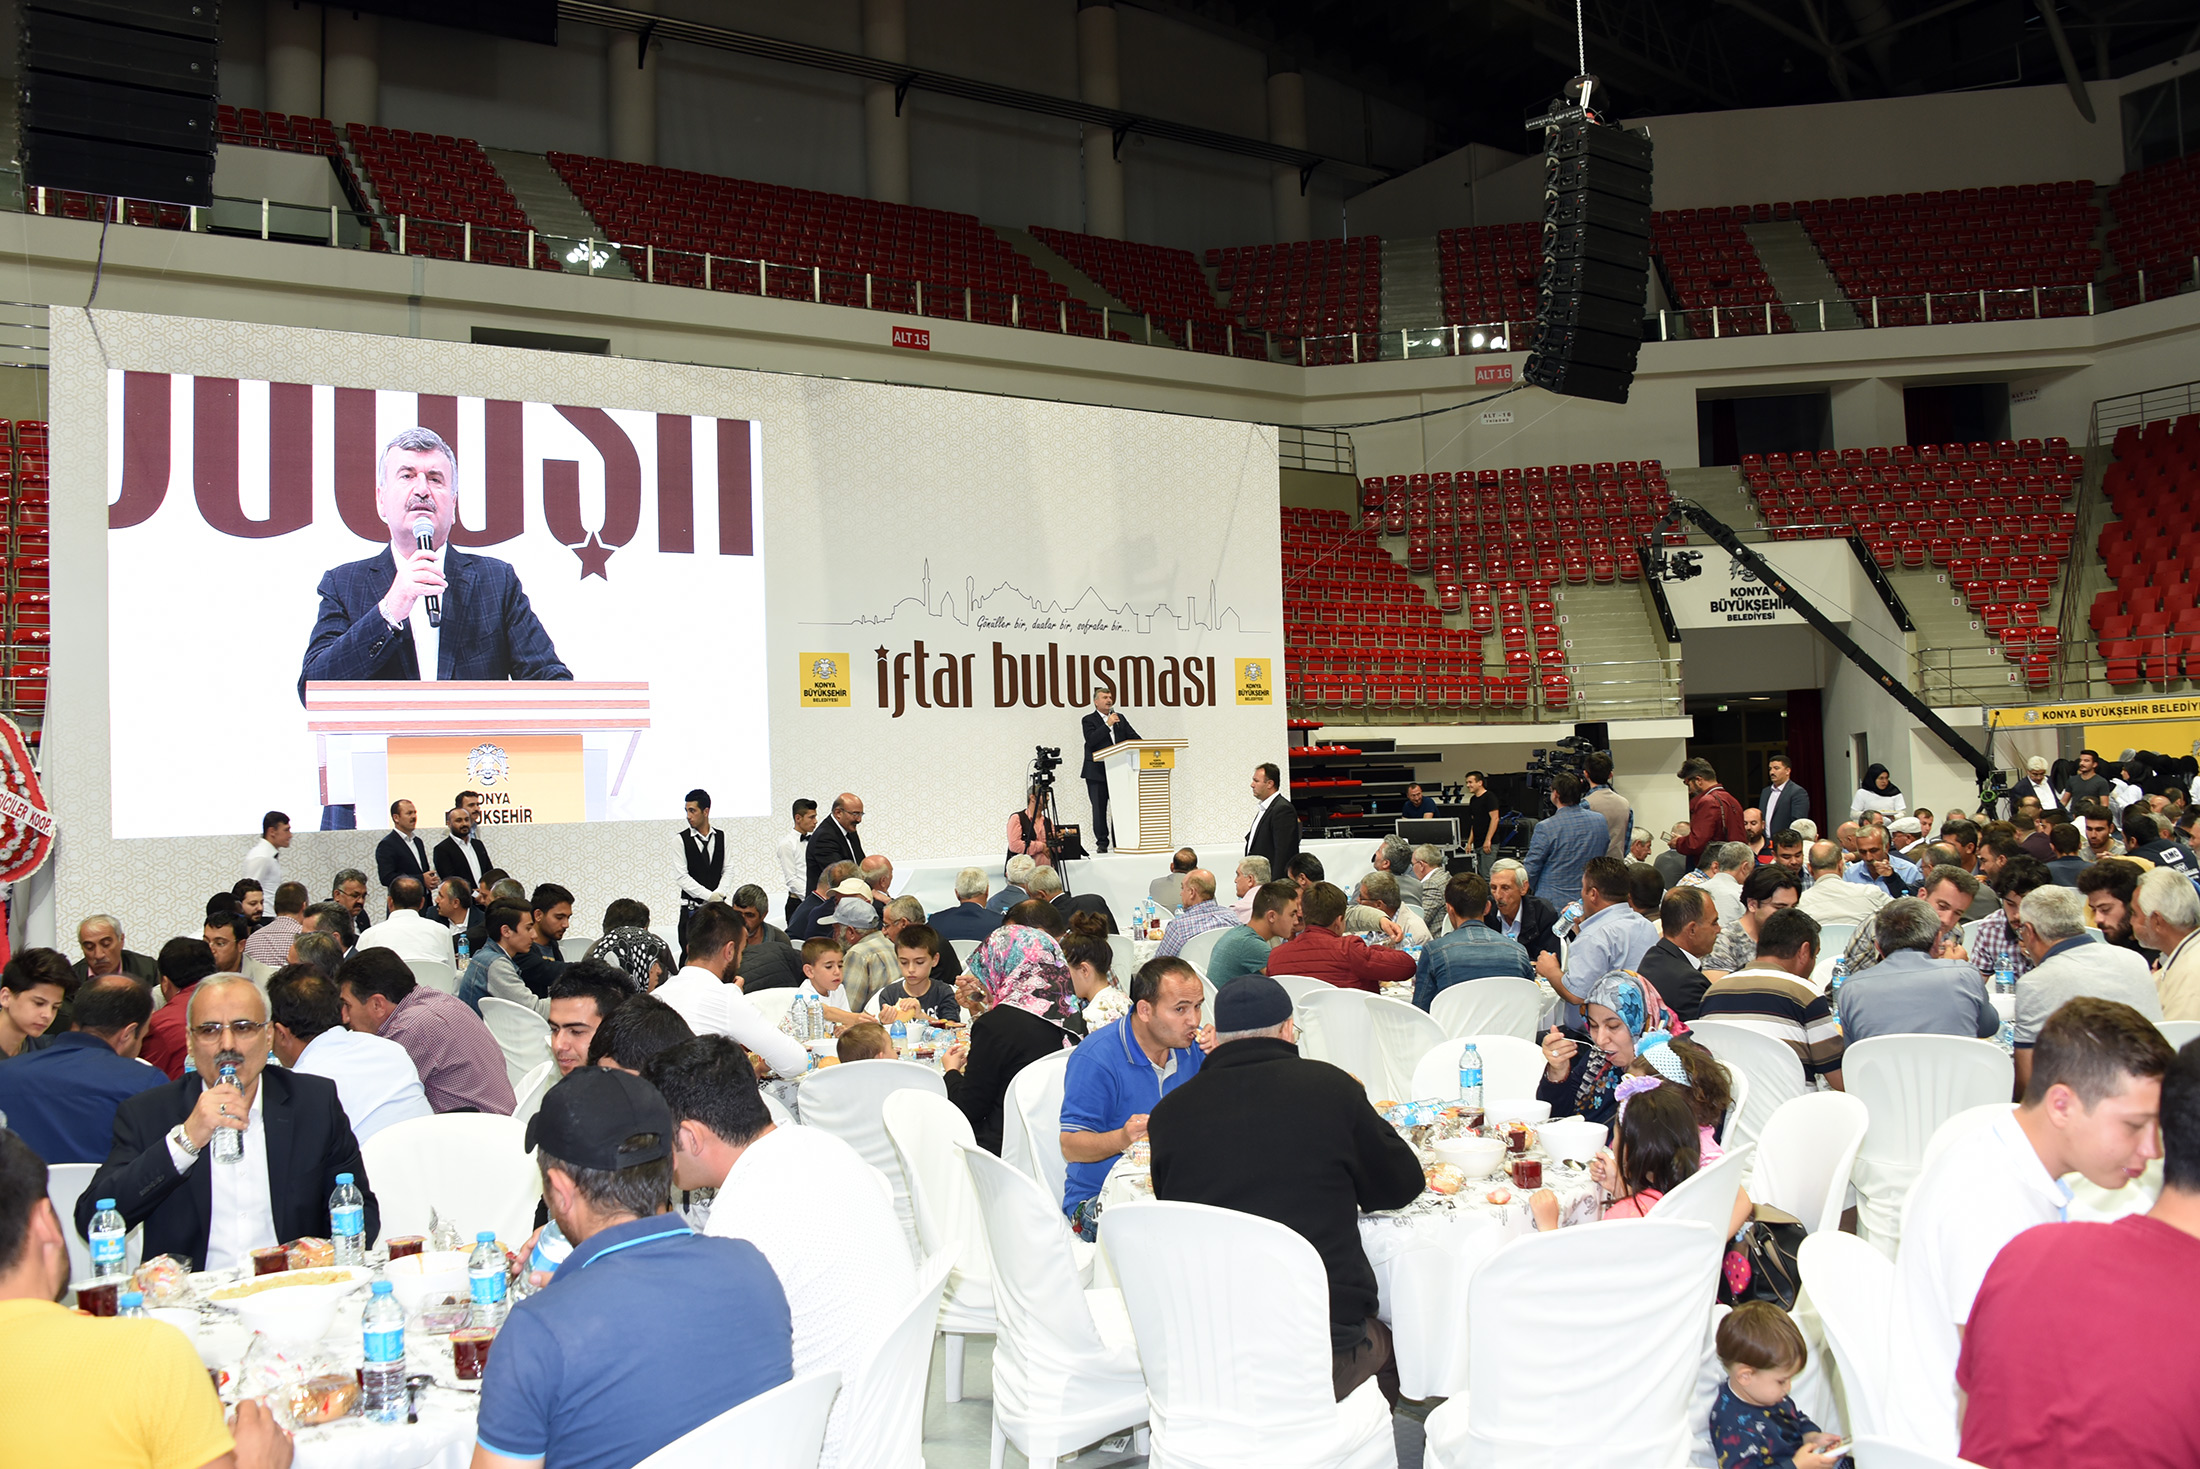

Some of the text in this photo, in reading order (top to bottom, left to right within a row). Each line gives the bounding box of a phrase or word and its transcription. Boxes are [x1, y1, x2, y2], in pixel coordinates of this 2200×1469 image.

[894, 331, 929, 346] ALT 15
[1477, 368, 1511, 380] ALT 16
[1730, 586, 1770, 597] KONYA
[1727, 610, 1776, 621] BELEDİYESİ
[976, 614, 1011, 631] Gönüller
[1013, 615, 1028, 631] bir,
[1032, 617, 1056, 630] dualar
[1059, 617, 1073, 632] bir,
[1077, 618, 1108, 634] sofralar
[874, 639, 976, 718] iftar
[2042, 700, 2200, 720] KONYA BÜYÜKŞEHİR BELEDİY
[477, 793, 511, 805] ONYA
[0, 791, 52, 834] İCİLER KOOP.
